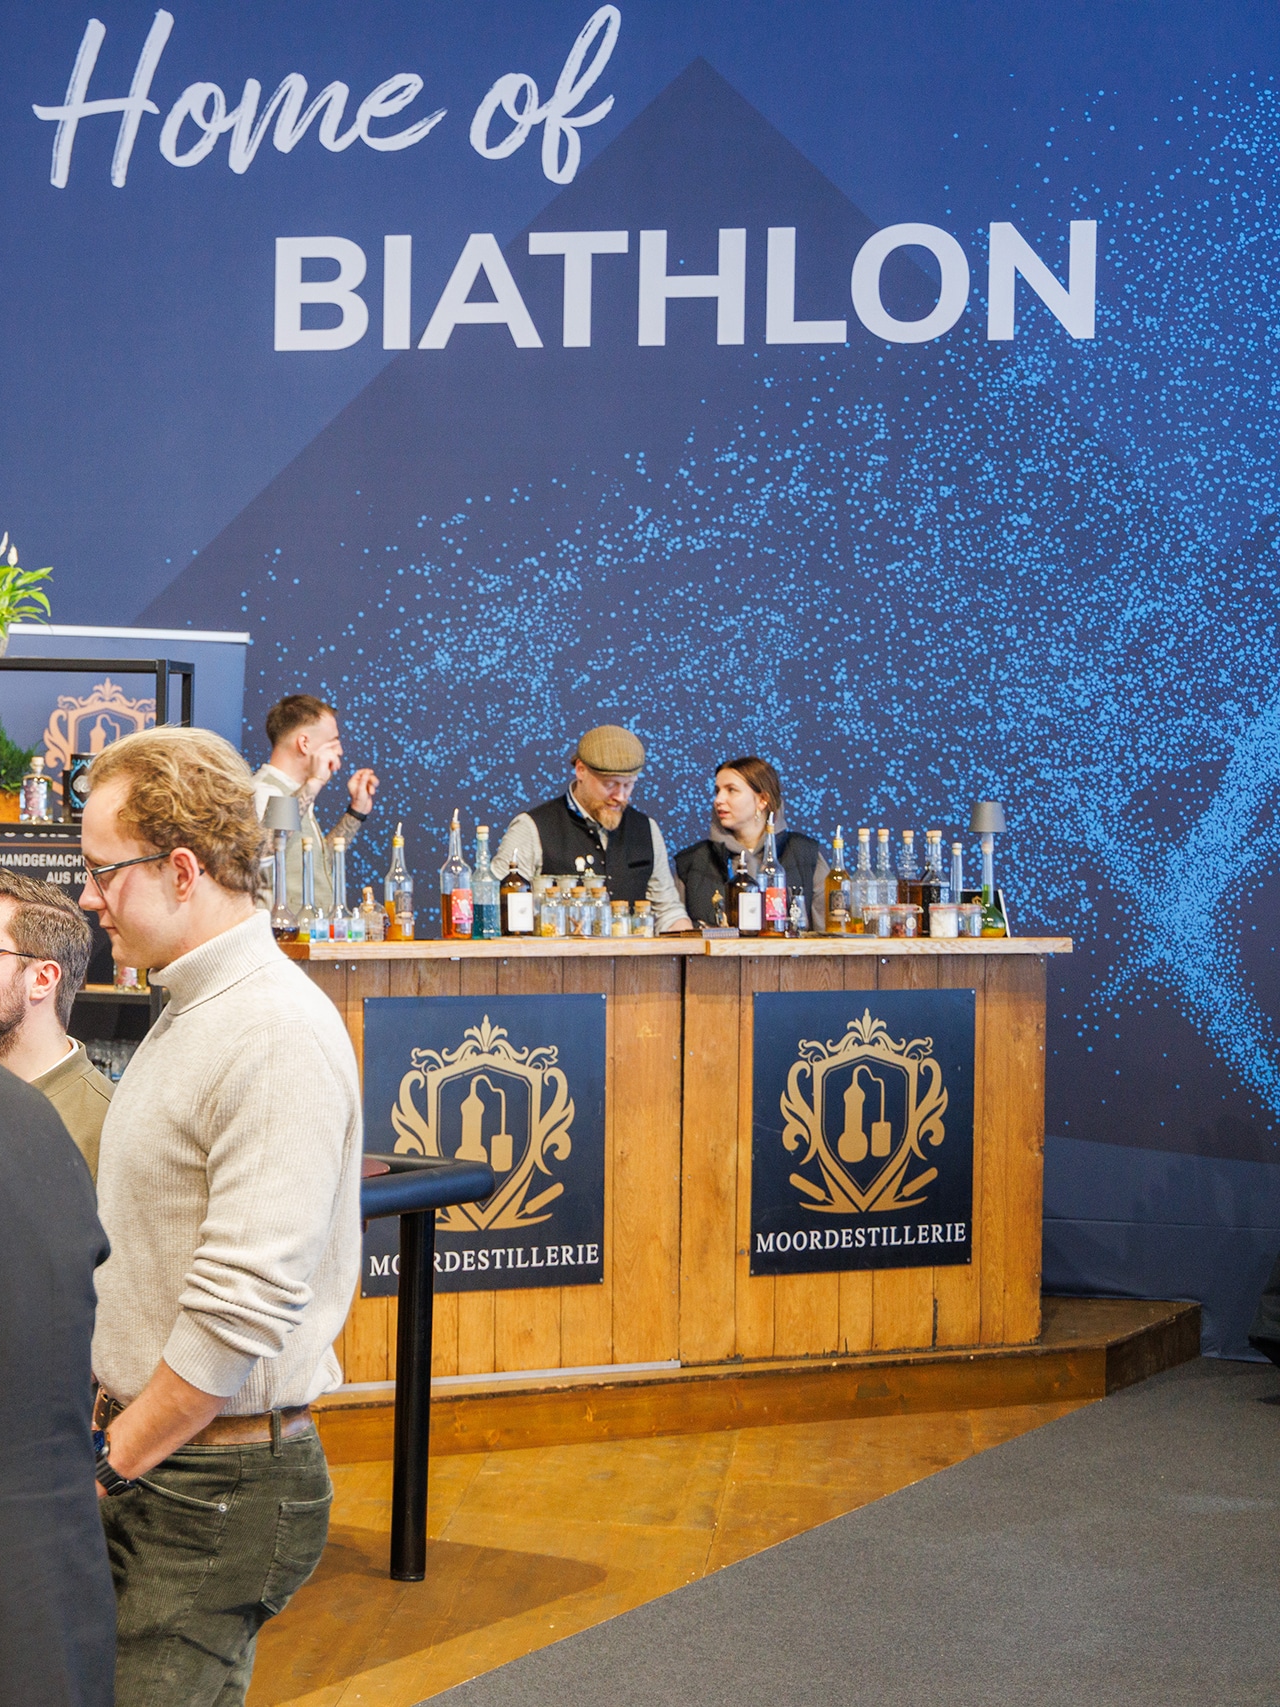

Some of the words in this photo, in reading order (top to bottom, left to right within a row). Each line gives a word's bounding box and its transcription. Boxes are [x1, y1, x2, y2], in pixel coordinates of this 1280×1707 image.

[32, 8, 448, 188] Home
[470, 4, 621, 184] of
[273, 219, 1098, 352] BIATHLON
[46, 870, 71, 885] AUS
[755, 1222, 967, 1254] MOORDESTILLERIE
[369, 1243, 600, 1277] MORDESTILLERIE
